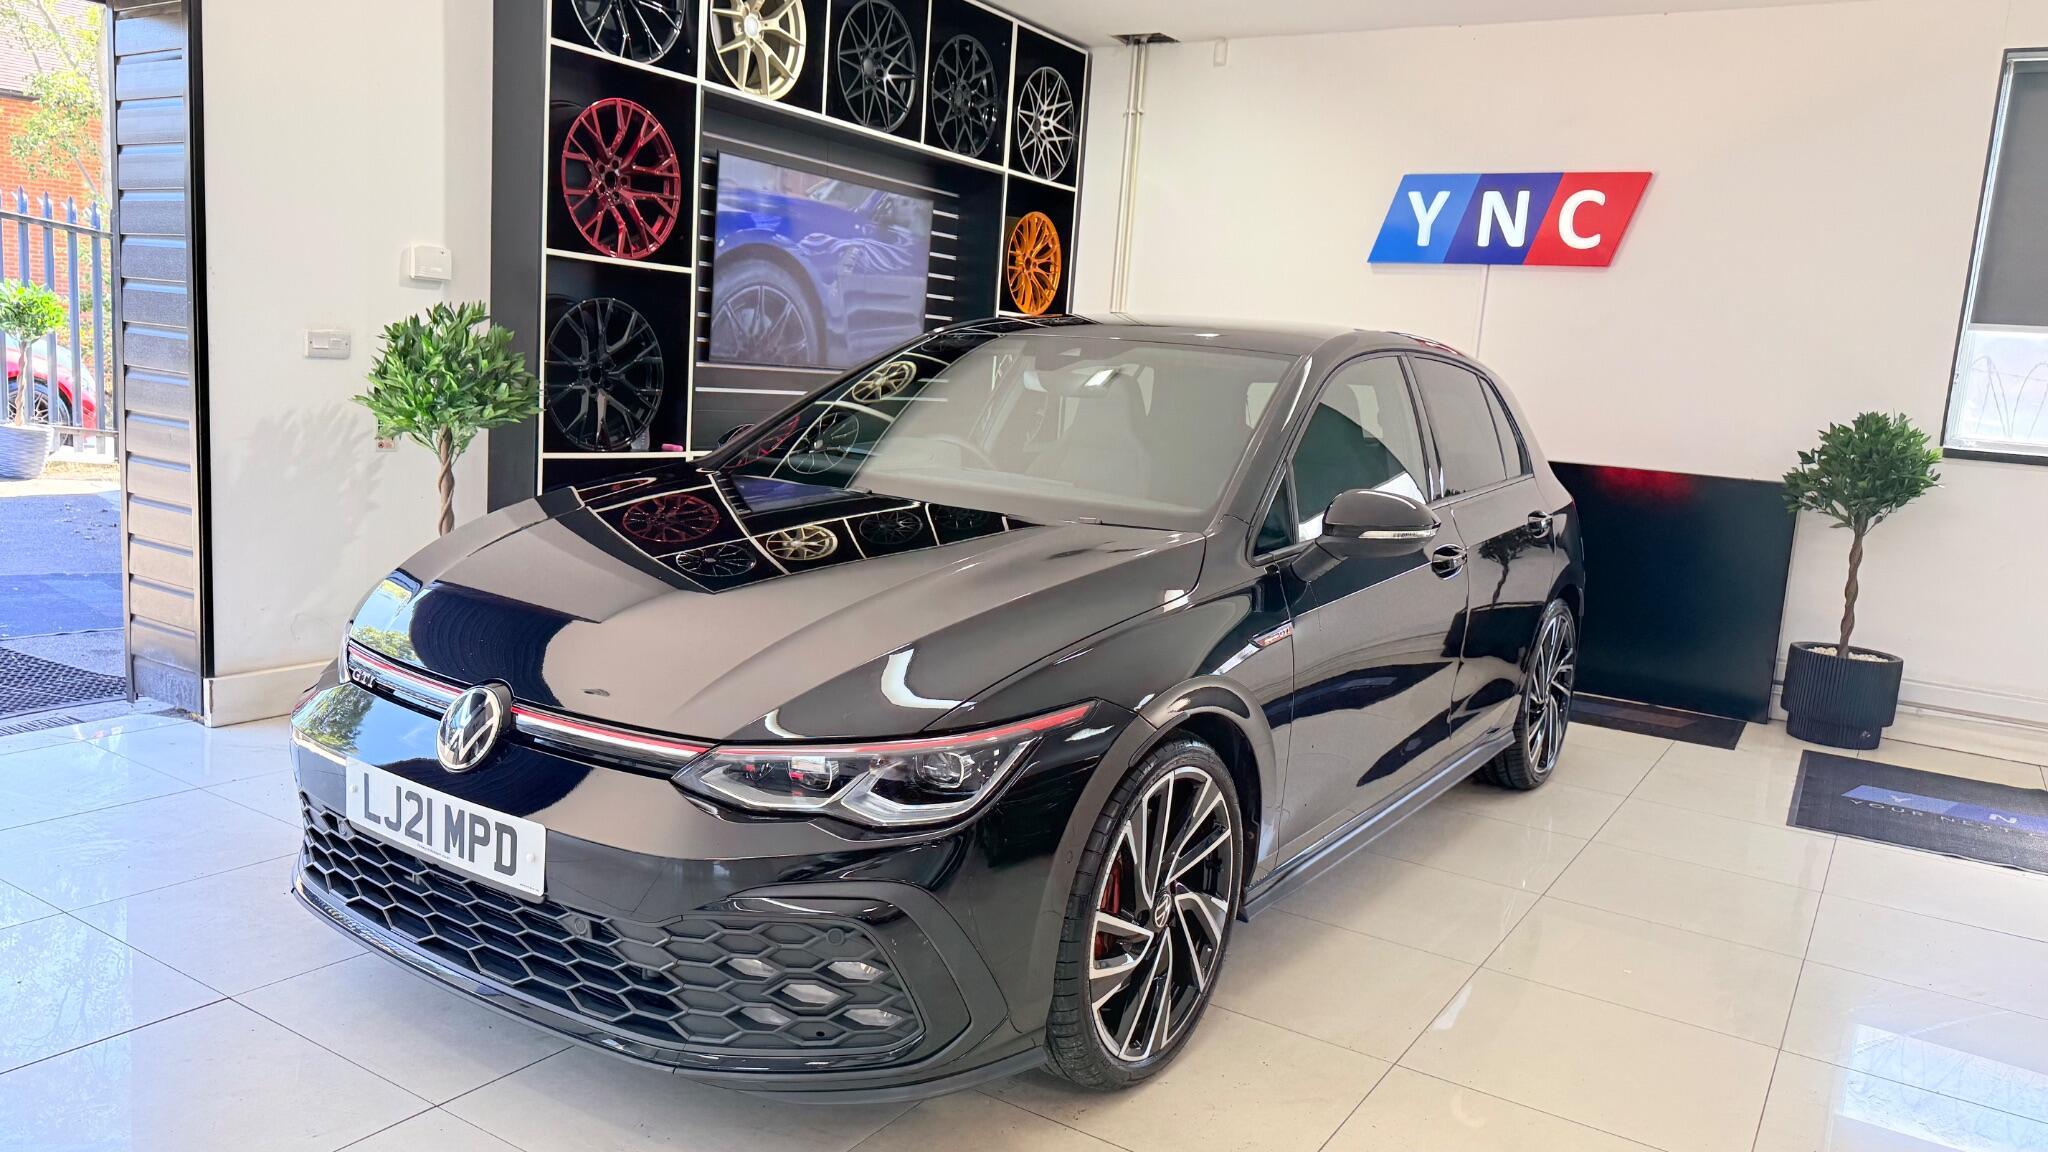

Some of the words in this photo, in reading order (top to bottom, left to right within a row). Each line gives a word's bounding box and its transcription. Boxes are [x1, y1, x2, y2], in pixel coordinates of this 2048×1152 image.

[1407, 189, 1606, 250] YNC
[364, 772, 433, 847] LJ21
[444, 804, 518, 877] MPD
[1850, 799, 1923, 817] YOUR
